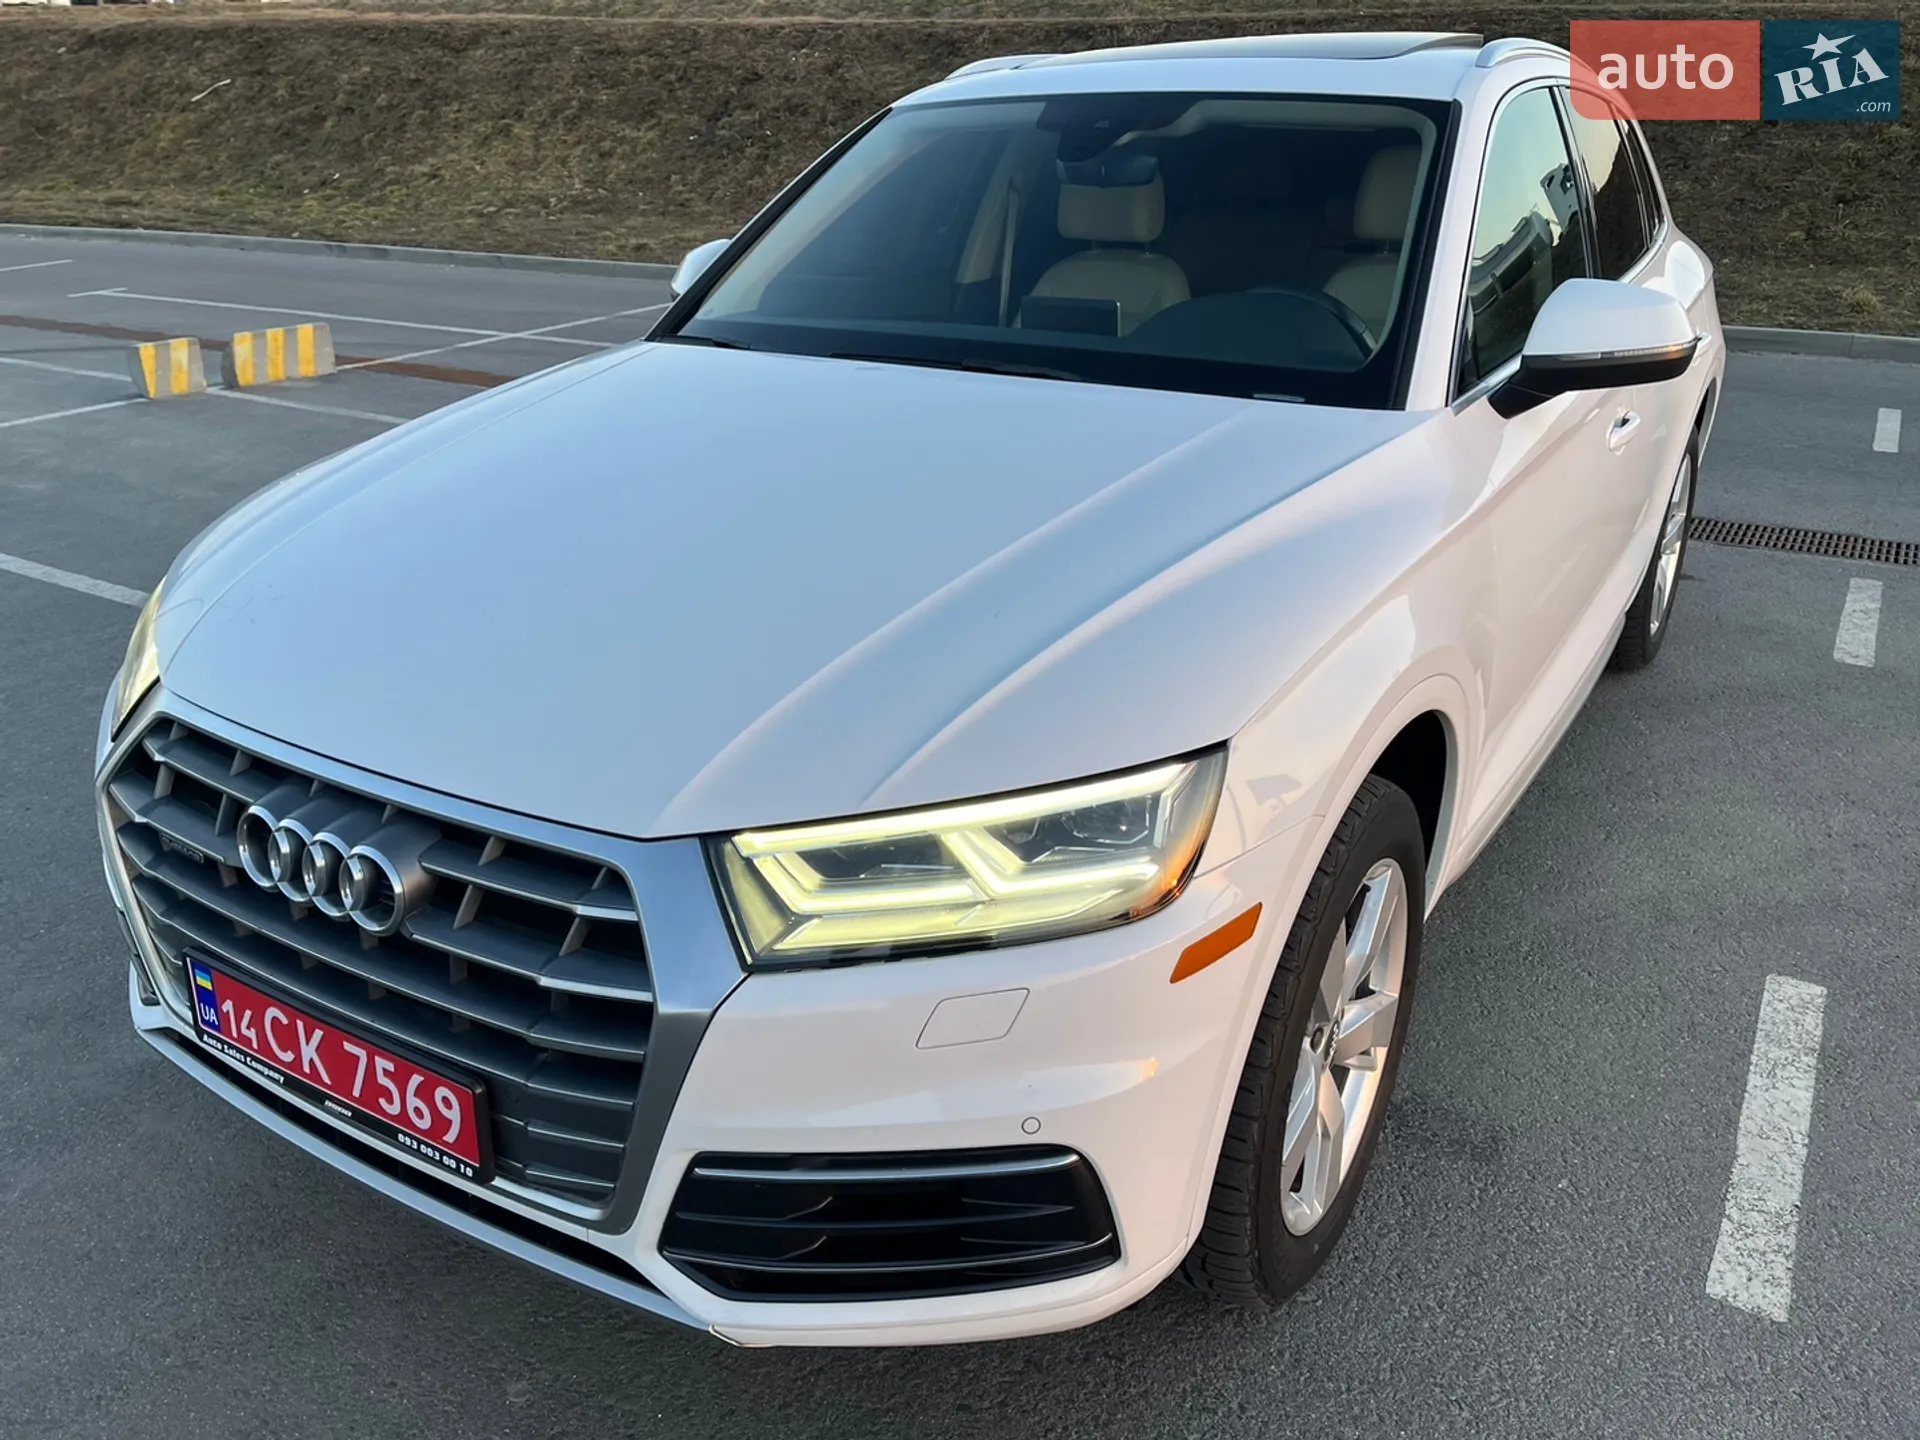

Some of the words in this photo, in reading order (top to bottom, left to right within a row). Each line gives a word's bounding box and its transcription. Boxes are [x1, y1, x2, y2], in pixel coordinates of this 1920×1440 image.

[200, 1002, 219, 1026] UA
[203, 1033, 222, 1050] Auto
[223, 1044, 245, 1062] Sales
[246, 1056, 284, 1084] Company
[343, 1041, 462, 1143] 7569
[398, 1133, 418, 1150] 093
[420, 1144, 440, 1161] 003
[443, 1155, 456, 1169] 00
[460, 1163, 473, 1177] 10
